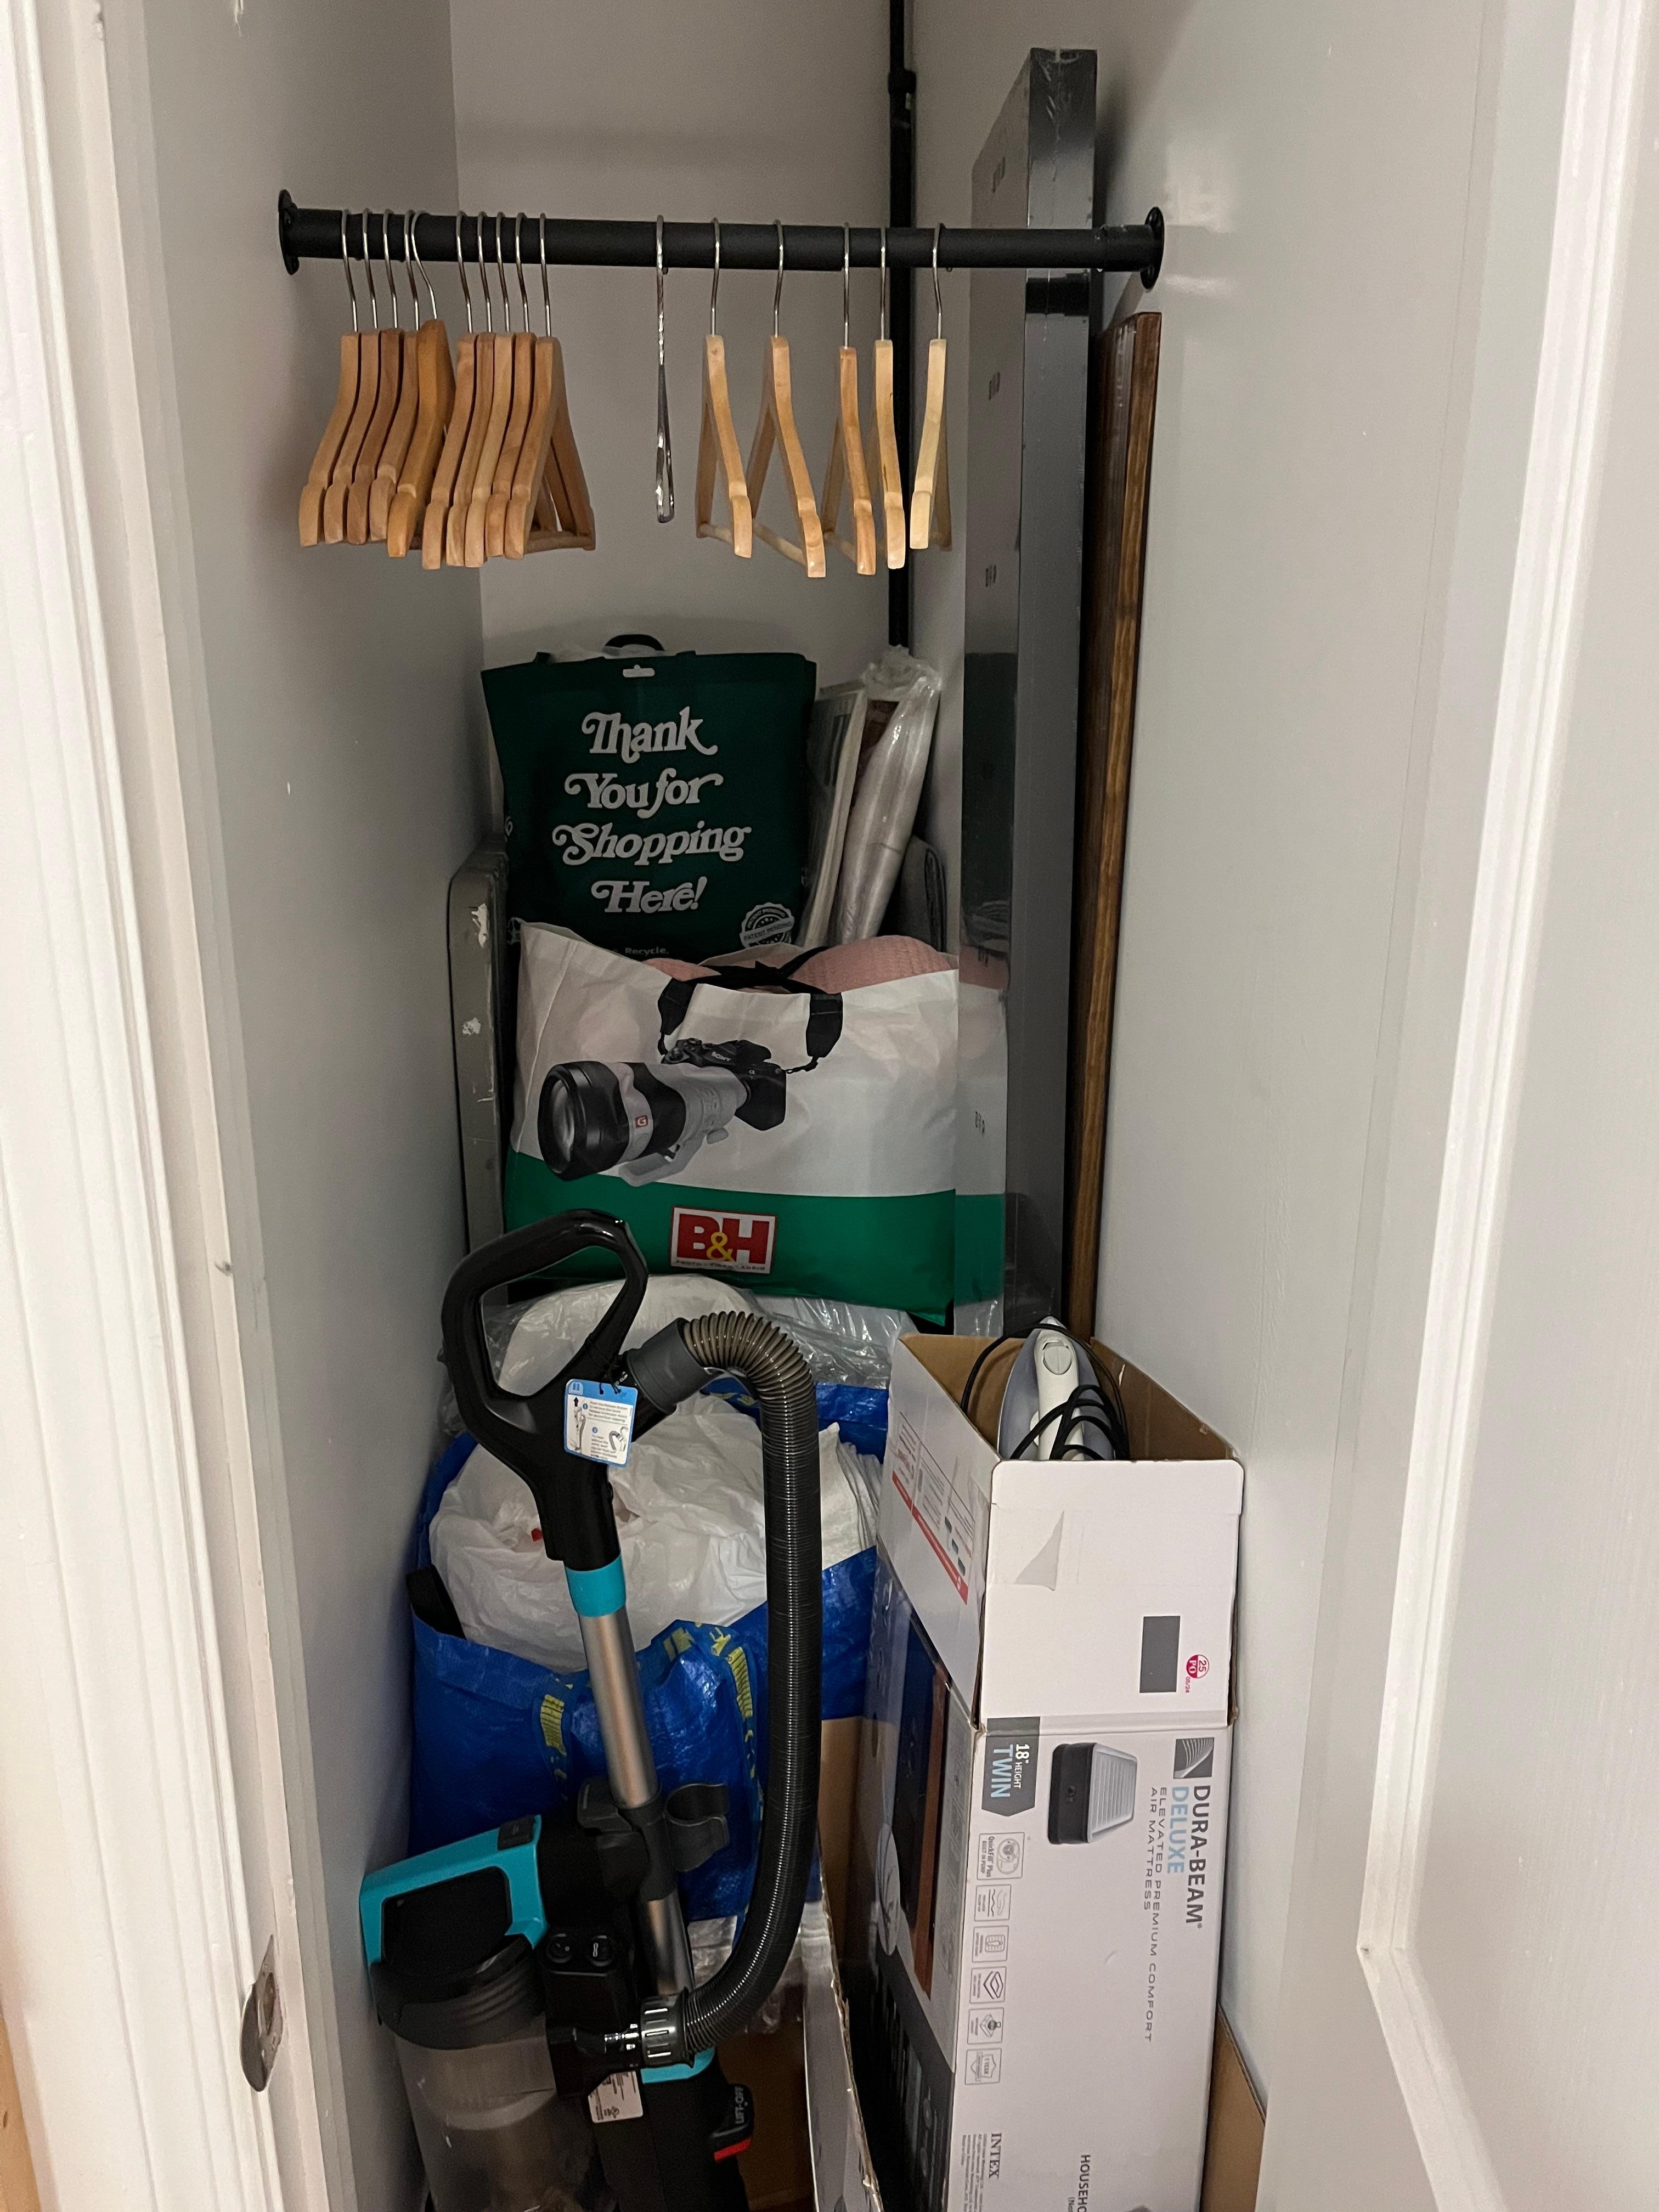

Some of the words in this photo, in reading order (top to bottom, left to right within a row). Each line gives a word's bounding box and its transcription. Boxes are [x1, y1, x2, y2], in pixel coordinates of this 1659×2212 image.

[582, 706, 718, 764] Thank
[565, 772, 650, 810] You
[637, 768, 724, 819] for
[552, 820, 752, 866] Shopping
[591, 876, 708, 913] Here!
[624, 946, 669, 956] Recycle.
[677, 1214, 770, 1265] B&H
[1188, 1660, 1197, 1674] PO
[1199, 1660, 1207, 1672] 25
[991, 1744, 1014, 1798] TWIN
[1013, 1762, 1023, 1789] HEIGHT
[1149, 1787, 1158, 1814] AIR
[1154, 1787, 1168, 1874] ELEVATED
[1167, 1786, 1189, 1875] DELUXE
[1143, 1819, 1156, 1911] MATTRESS
[1149, 1880, 1162, 1957] PREMIUM
[1143, 1962, 1156, 2044] COMFORT
[734, 2086, 745, 2124] LIFT-OFF
[989, 2132, 1002, 2180] INTEX
